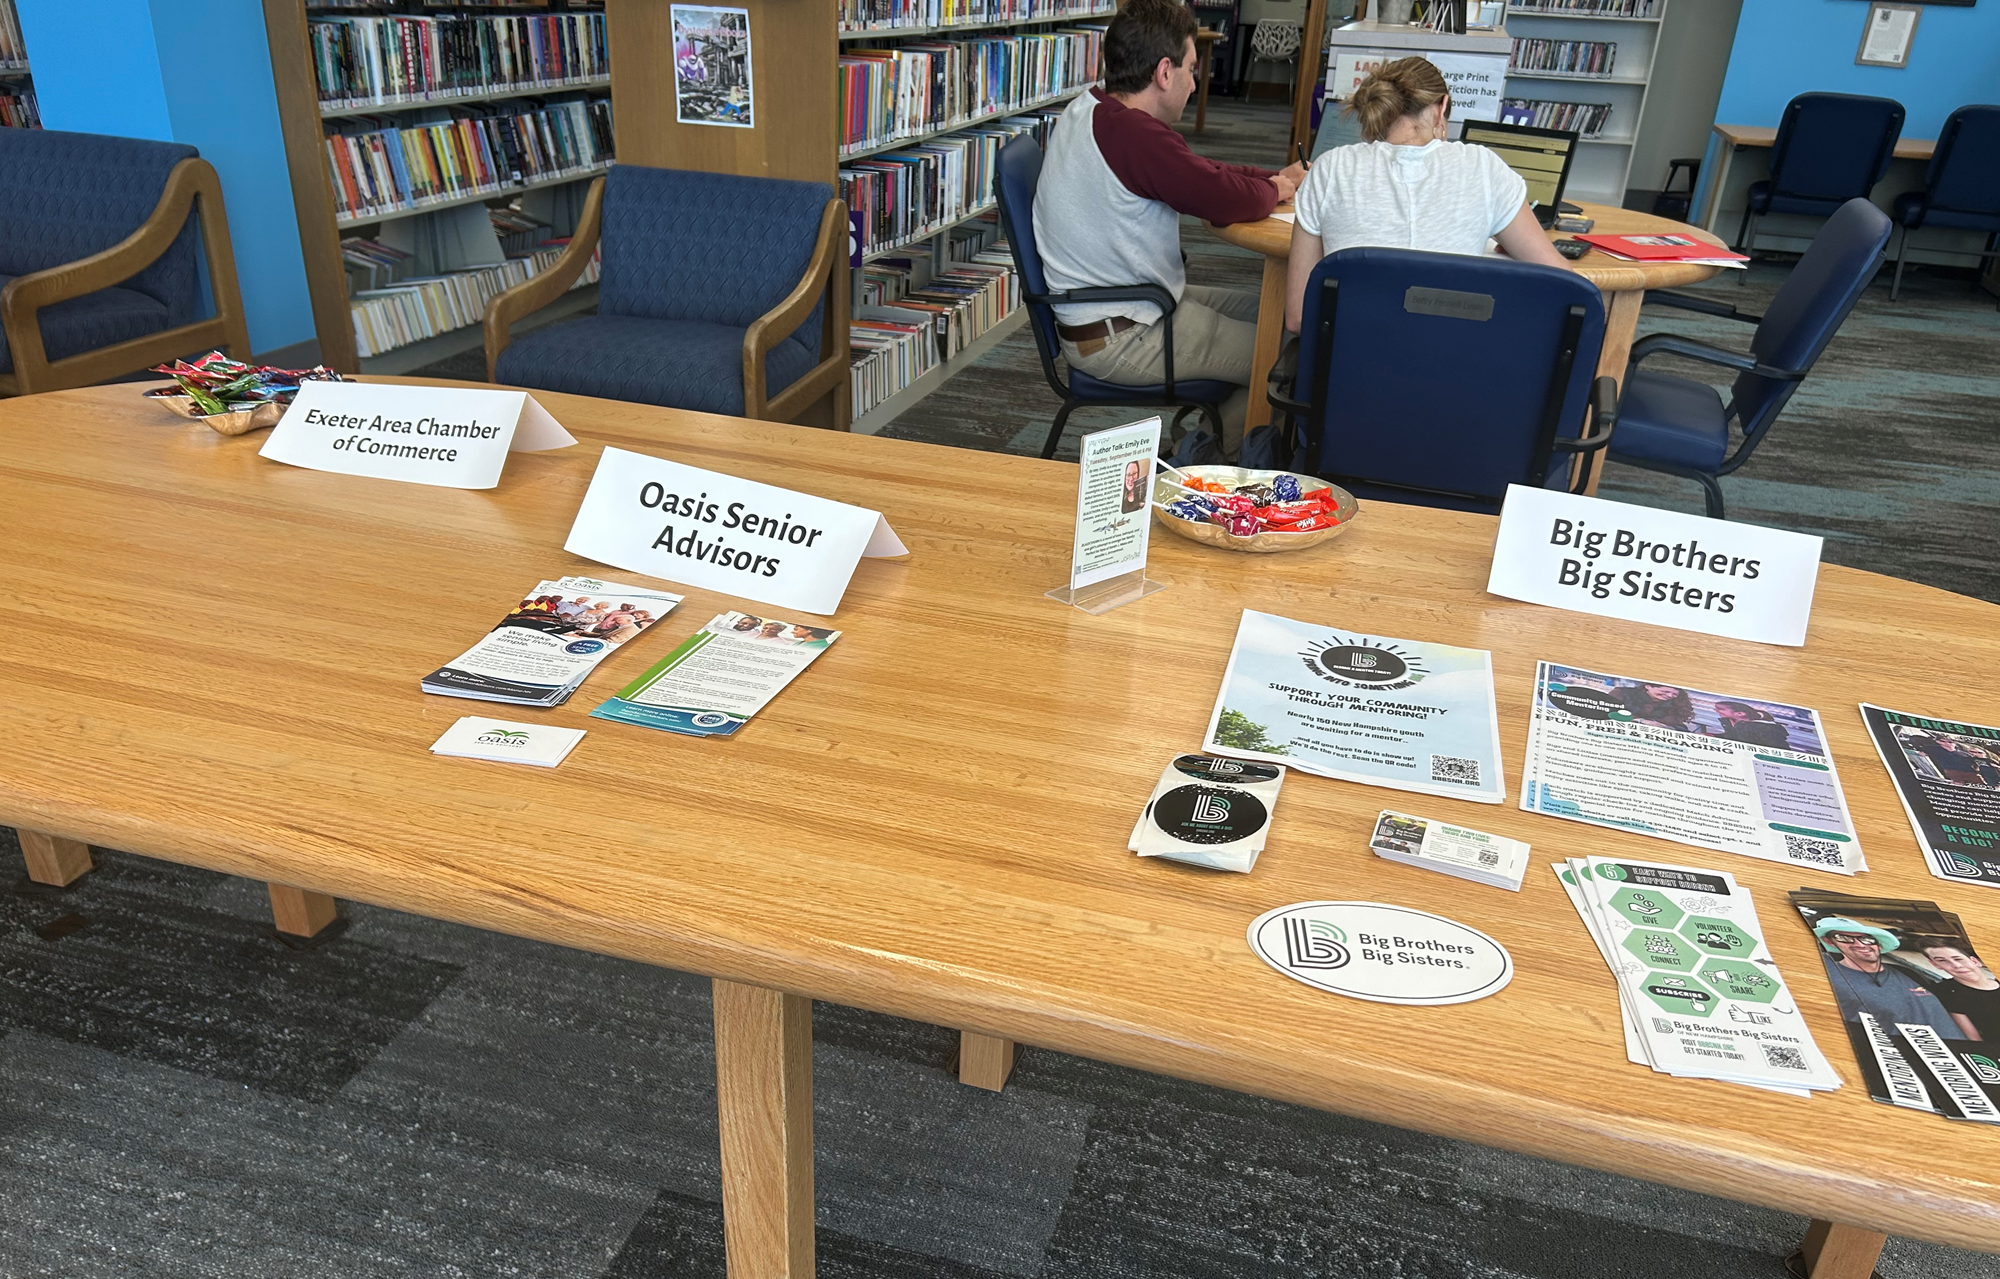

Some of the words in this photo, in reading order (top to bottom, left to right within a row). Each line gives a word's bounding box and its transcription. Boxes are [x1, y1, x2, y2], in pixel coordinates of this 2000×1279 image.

[1443, 72, 1464, 82] arge
[1466, 72, 1489, 83] Print
[1448, 84, 1478, 95] Fiction
[1480, 87, 1497, 97] has
[304, 409, 367, 430] Exeter
[368, 415, 412, 434] Area
[416, 418, 500, 440] Chamber
[333, 435, 358, 451] of
[357, 437, 457, 462] Commerce
[1092, 447, 1111, 456] Author
[1125, 440, 1140, 449] Emily
[639, 481, 720, 523] Oasis
[722, 502, 823, 548] Senior
[651, 525, 780, 577] Advisors
[1550, 518, 1607, 559] Big
[1612, 529, 1761, 580] Brothers
[1558, 558, 1616, 599] Big
[1619, 570, 1735, 614] Sisters
[495, 637, 529, 647] simple.
[501, 634, 531, 645] senior
[531, 637, 558, 648] living
[508, 629, 522, 637] We
[524, 632, 552, 642] make
[1302, 657, 1326, 676] SPRING
[1323, 675, 1350, 686] INTO
[1354, 679, 1416, 691] SOMETHING
[1268, 682, 1322, 699] SUPPORT
[1326, 693, 1361, 704] YOUR
[1366, 699, 1449, 715] COMMUNITY
[1550, 691, 1598, 705] Community
[1598, 699, 1625, 709] Based
[1565, 699, 1609, 712] Mentoring
[1287, 694, 1344, 709] THROUGH
[1349, 703, 1428, 720] MENTORING!
[1287, 710, 1315, 722] Nearly
[1331, 719, 1352, 728] New
[1353, 722, 1398, 734] Hampshire
[1399, 729, 1425, 738] youth
[1316, 724, 1349, 736] waiting
[1350, 728, 1364, 737] for
[1883, 711, 1905, 723] IT
[1907, 716, 1967, 735] TAKES
[1544, 715, 1582, 728] FUN,
[1585, 723, 1626, 735] FREE
[1644, 733, 1734, 755] ENGAGING
[1318, 740, 1332, 749] you
[1334, 744, 1353, 752] have
[1381, 751, 1402, 760] show
[1319, 746, 1332, 754] the
[1370, 755, 1384, 763] the
[1395, 760, 1417, 769] code!
[1935, 785, 1974, 796] Brothers
[1928, 800, 1966, 810] Mentors
[1950, 809, 1983, 817] provide
[1935, 812, 1996, 824] opportunities.
[1941, 824, 2000, 840] BECOME
[1947, 834, 1958, 843] A
[1960, 836, 1994, 848] BIG!
[1603, 864, 1618, 880] 5
[1642, 915, 1659, 925] GIVE
[1694, 922, 1733, 934] VOLUNTEER
[1358, 933, 1390, 950] Big
[1393, 936, 1475, 955] Brothers
[1362, 948, 1394, 965] Big
[1650, 955, 1682, 966] CONNECT
[1655, 987, 1704, 999] SUBSCRIBE
[1729, 984, 1756, 996] SHARE
[1757, 1014, 1773, 1024] LIKE
[1673, 1020, 1692, 1032] Big
[1694, 1023, 1740, 1037] Brothers
[1741, 1030, 1761, 1040] Big
[1679, 1038, 1696, 1046] VISIT
[1904, 1027, 1949, 1059] WORKS
[1683, 1046, 1695, 1055] GET
[1695, 1048, 1723, 1058] STARTED
[1723, 1051, 1746, 1061] TODAY!
[1931, 1060, 1994, 1116] MENTORING
